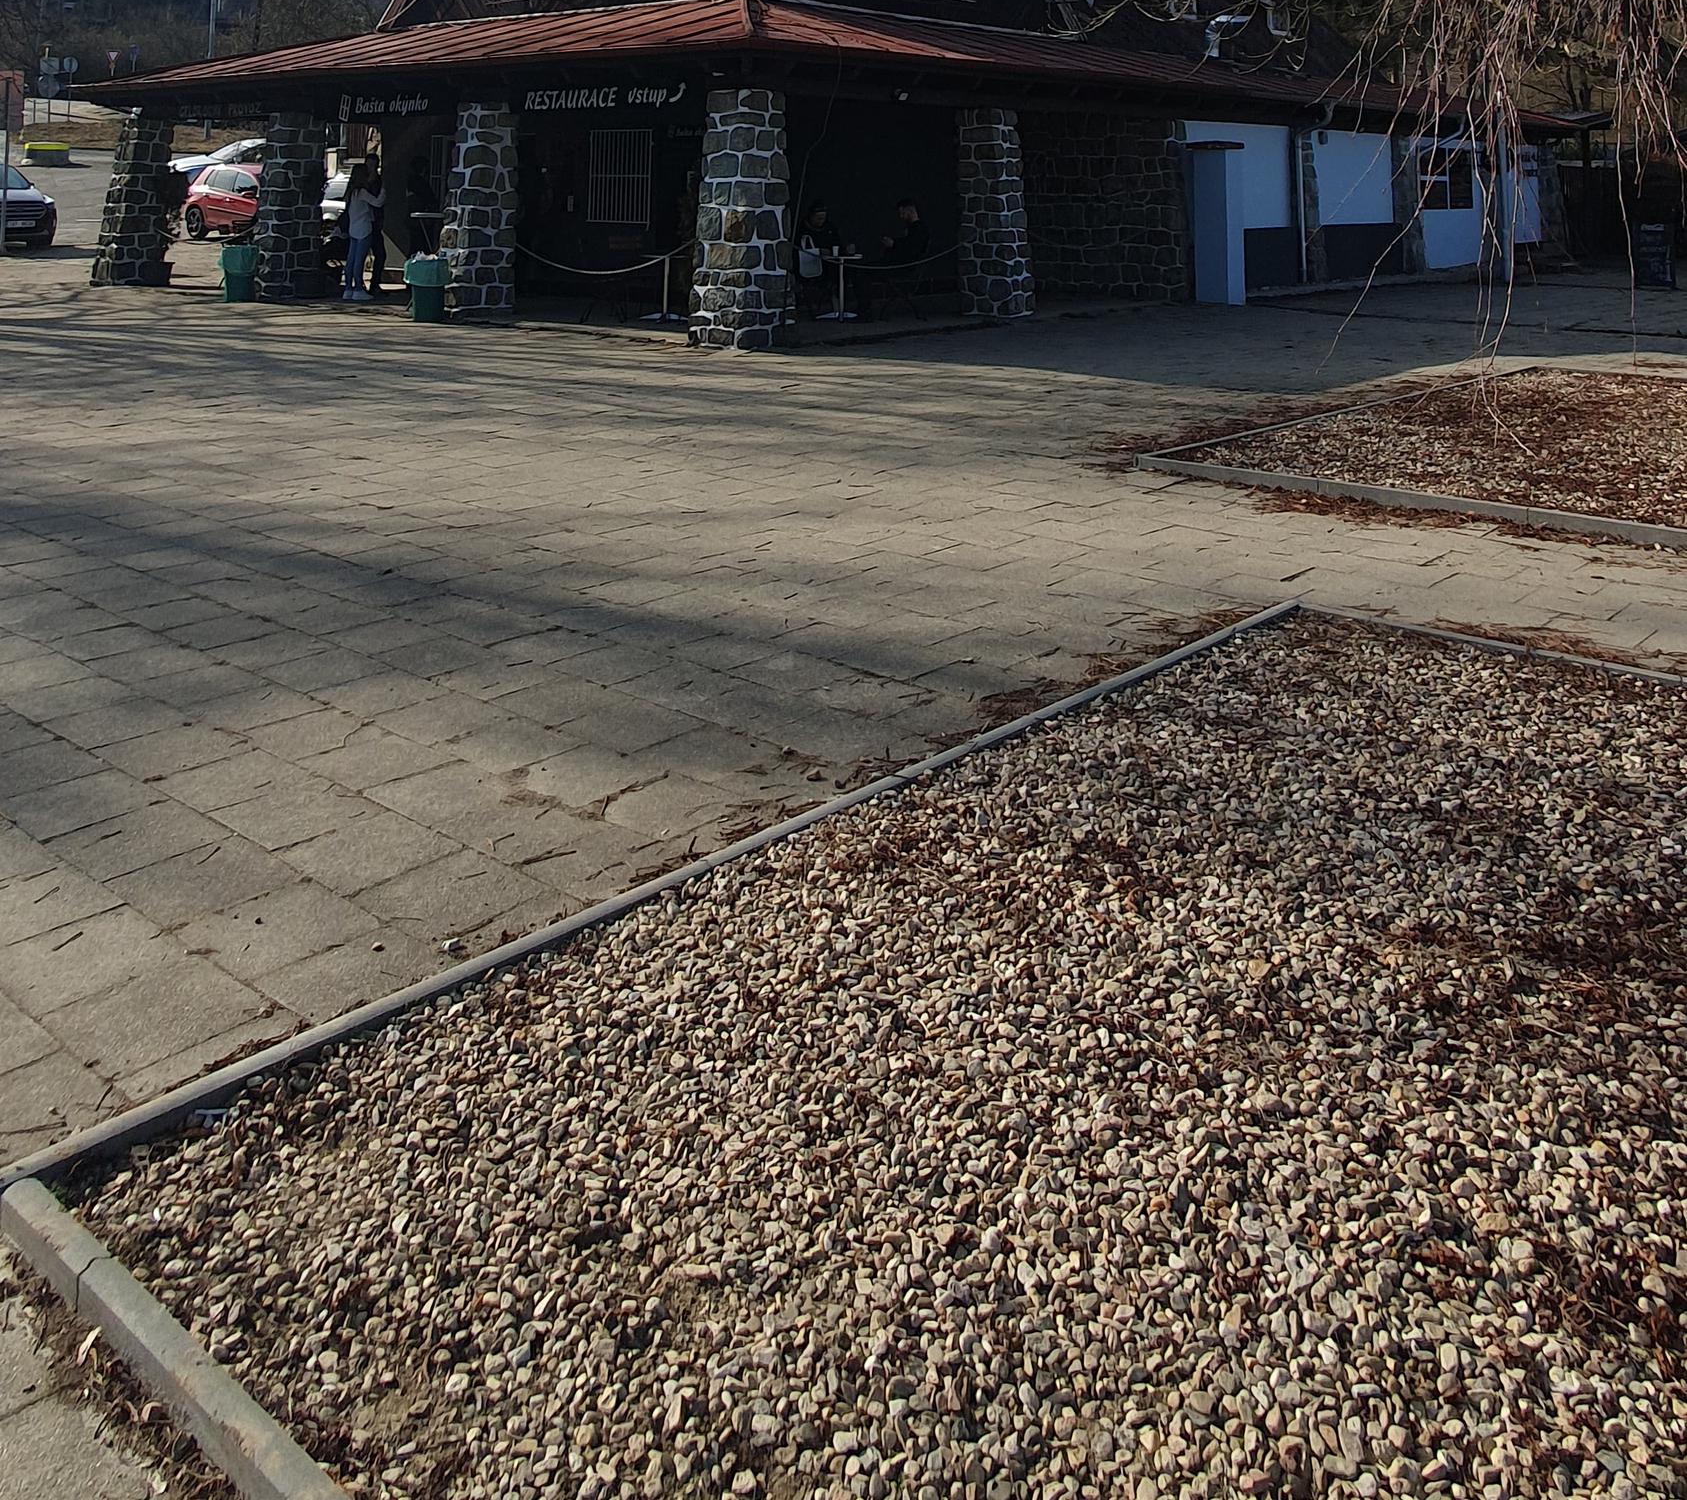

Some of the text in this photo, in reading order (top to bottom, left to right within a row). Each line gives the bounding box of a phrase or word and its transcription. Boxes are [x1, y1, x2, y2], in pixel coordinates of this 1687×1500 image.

[355, 92, 429, 116] Bašta okýnko
[524, 87, 667, 110] RESTAURACE vstup
